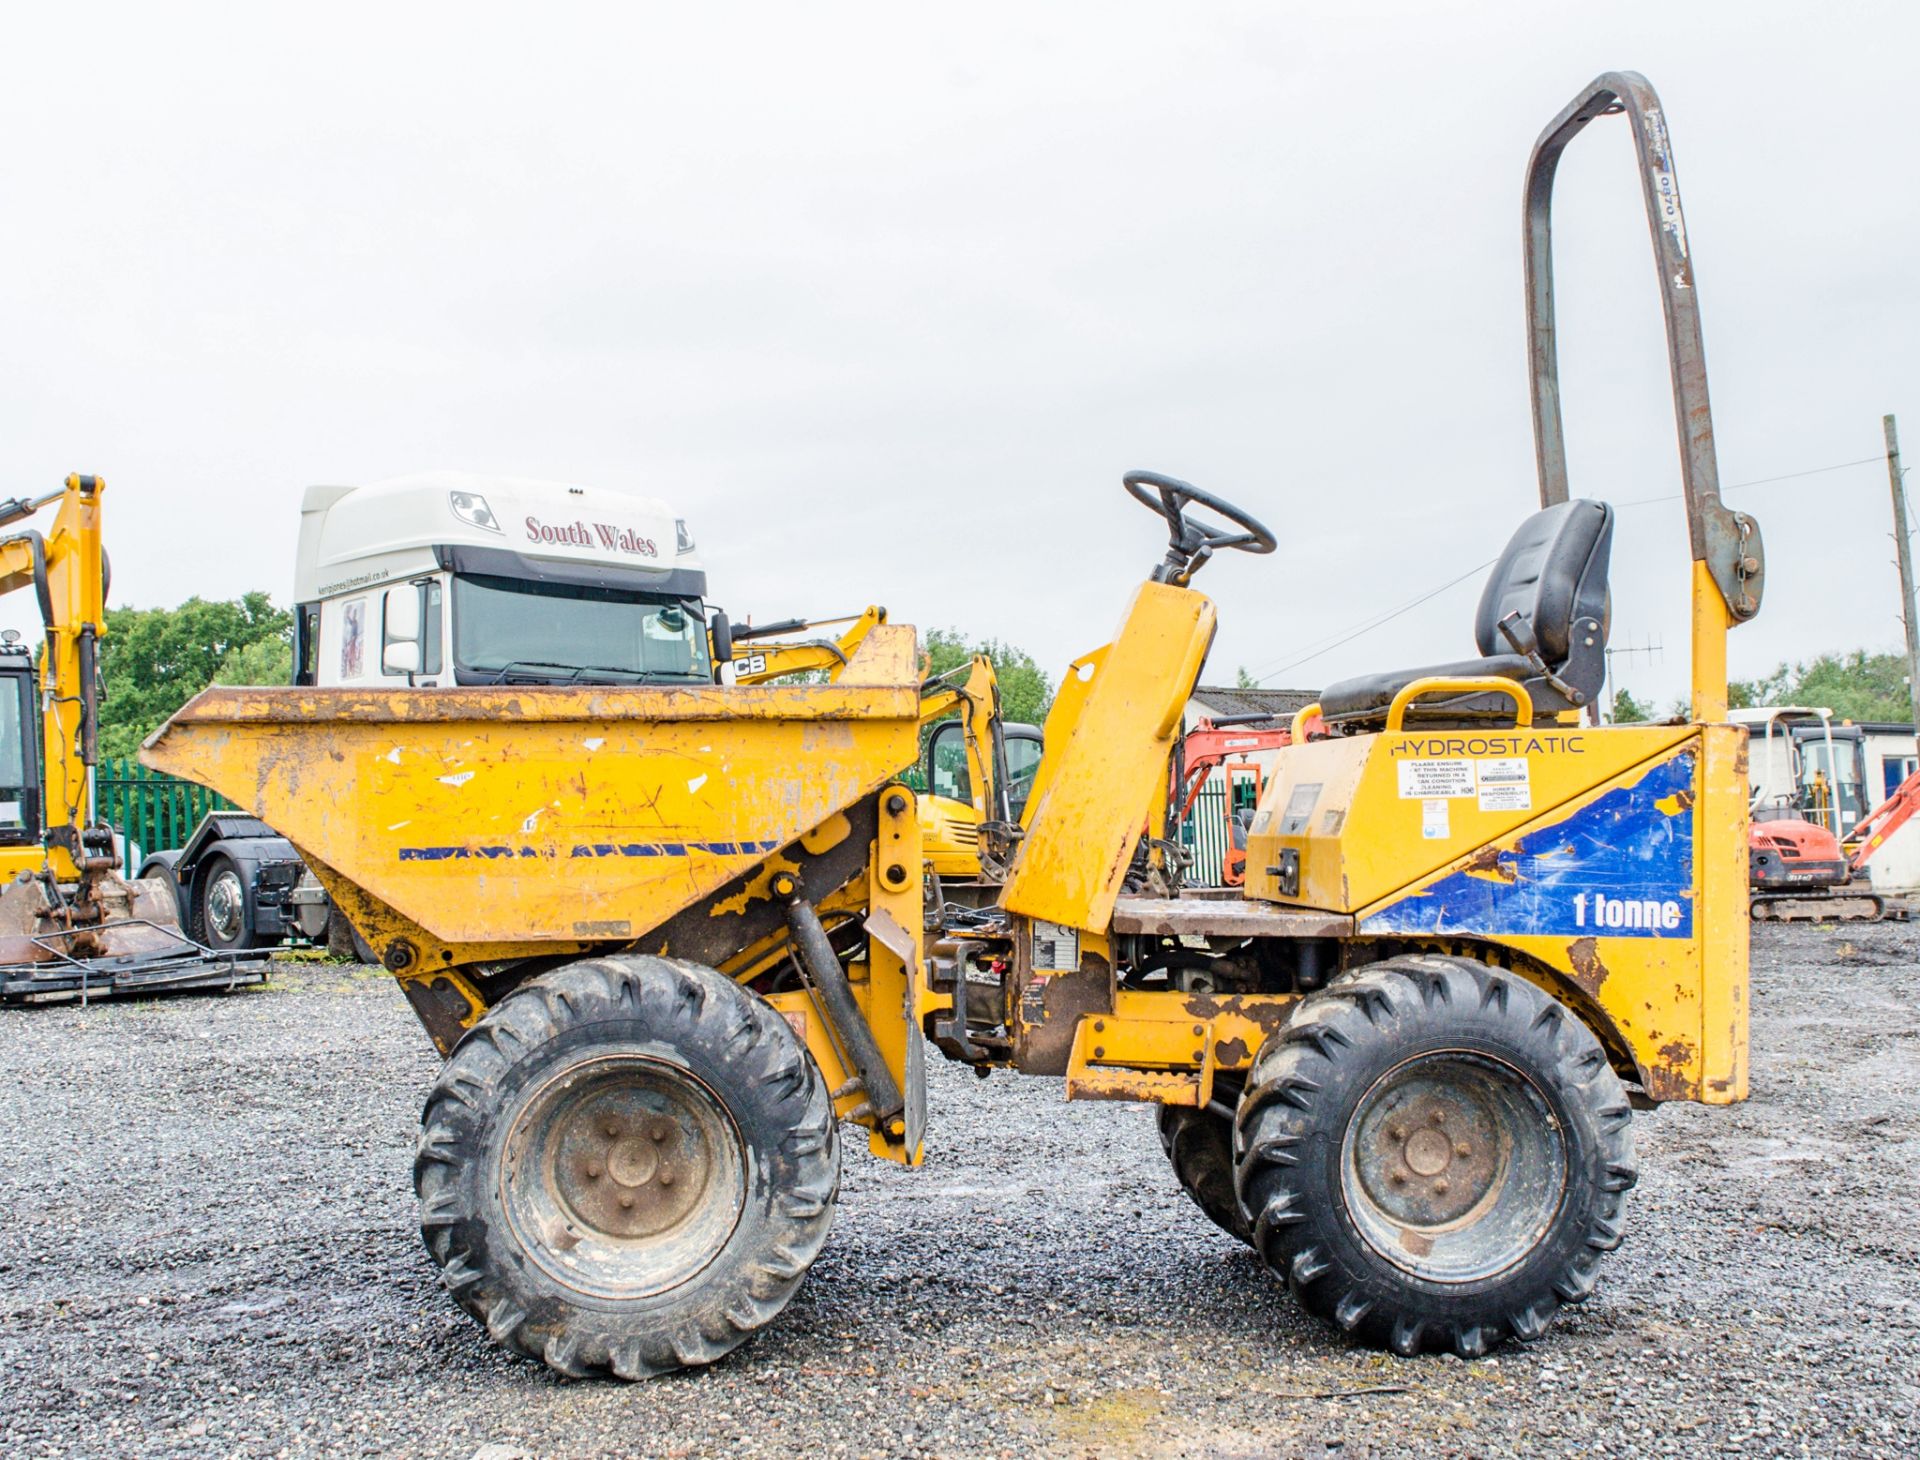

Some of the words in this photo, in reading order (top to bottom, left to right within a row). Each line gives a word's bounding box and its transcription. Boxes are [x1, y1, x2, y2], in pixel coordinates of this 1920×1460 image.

[1661, 176, 1675, 216] 0870
[525, 516, 594, 548] South
[592, 523, 658, 557] Wales
[734, 655, 766, 676] CB
[1390, 737, 1585, 756] HYDROSTATIC
[1573, 893, 1585, 926] 1
[1595, 893, 1681, 928] tonne
